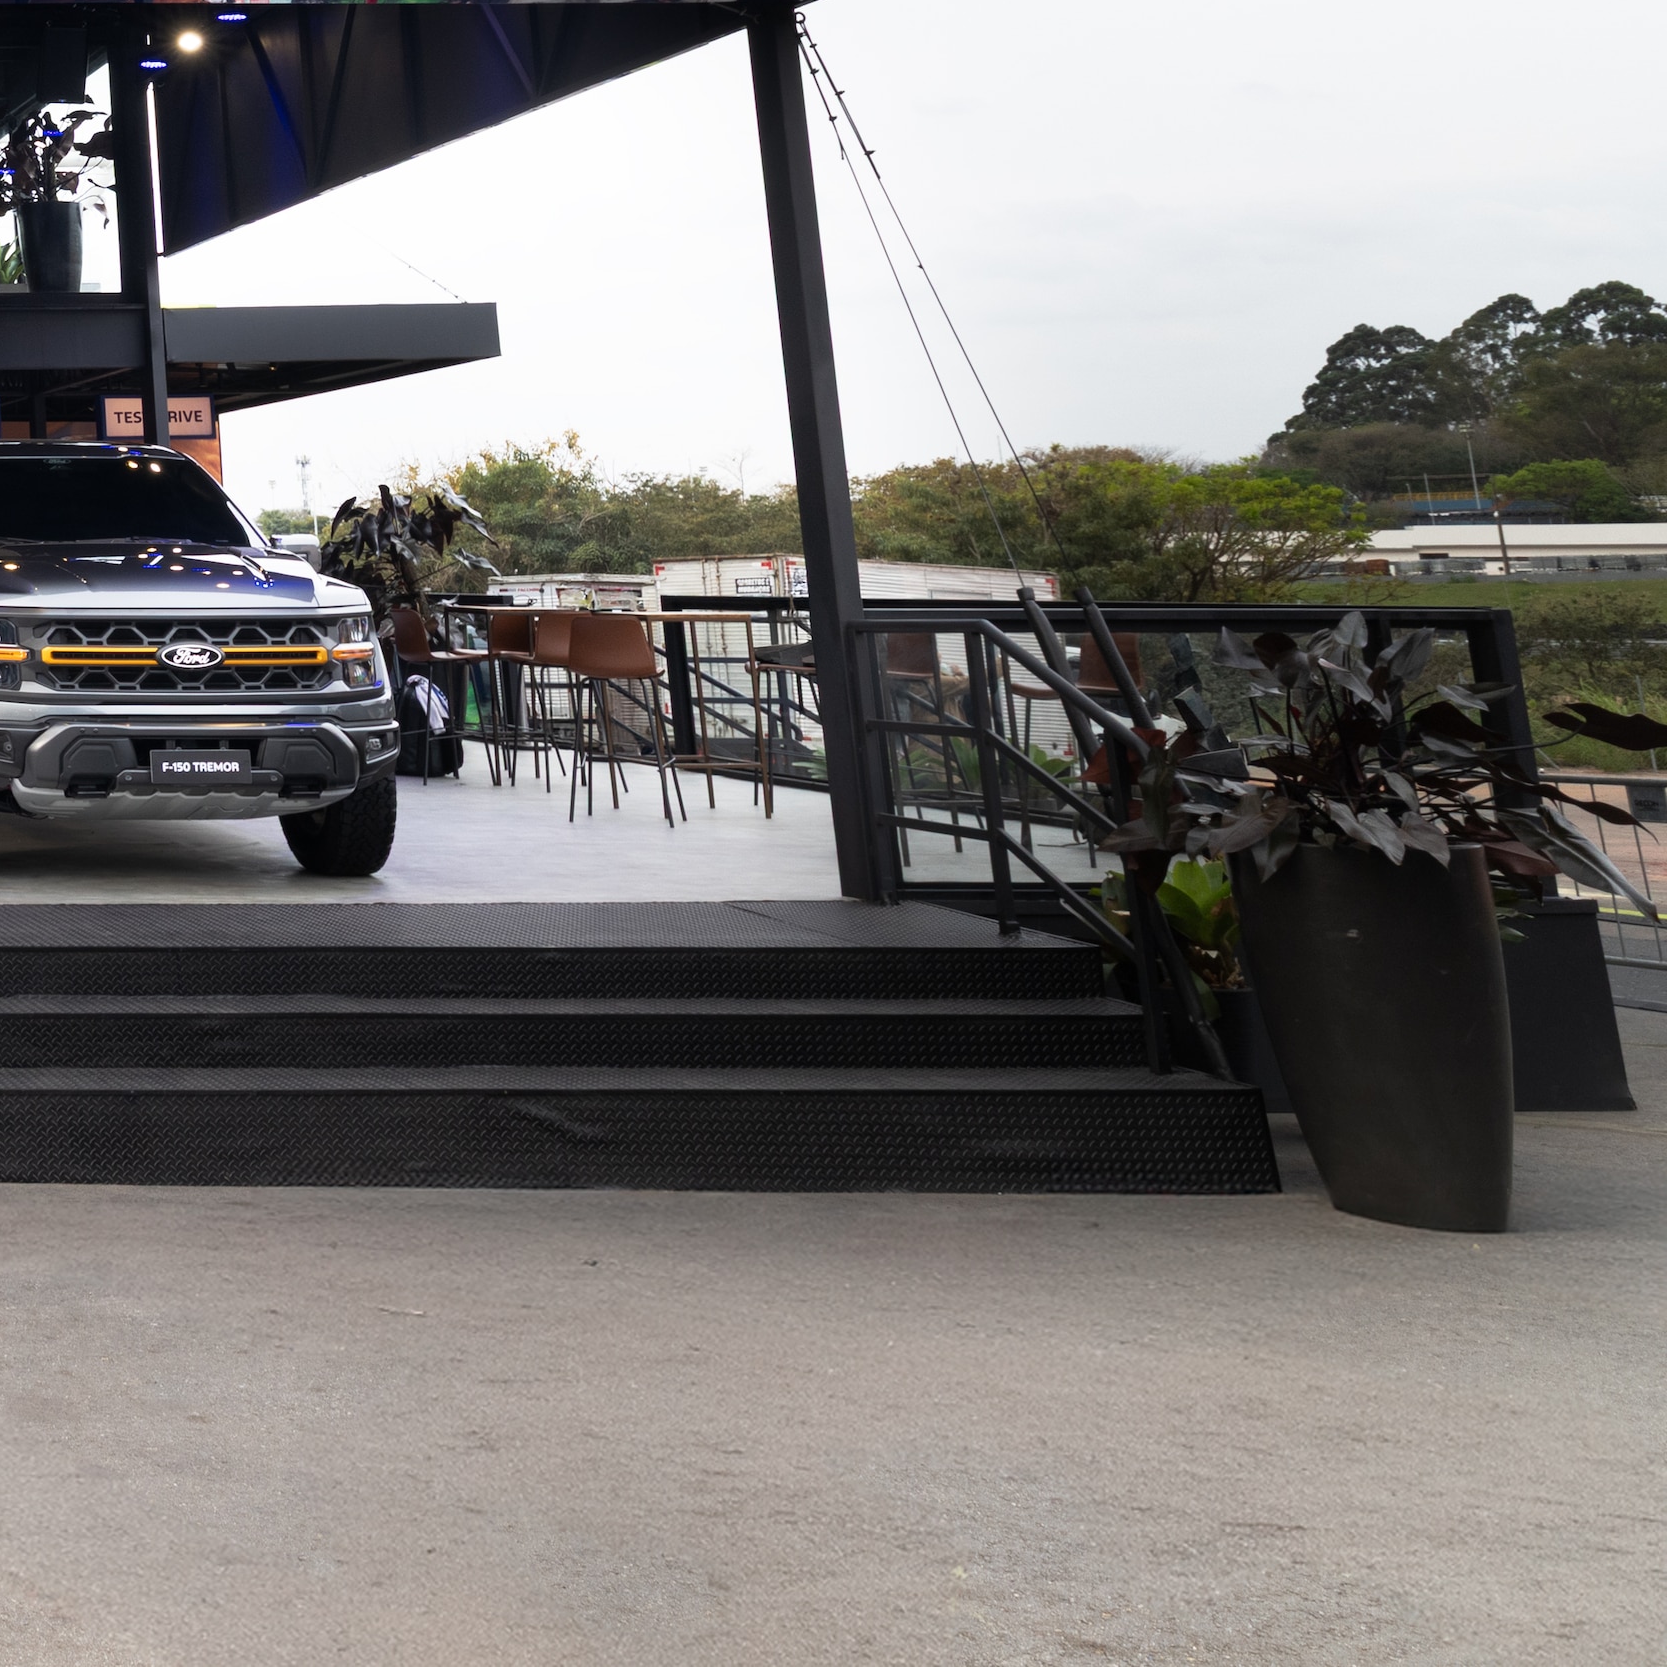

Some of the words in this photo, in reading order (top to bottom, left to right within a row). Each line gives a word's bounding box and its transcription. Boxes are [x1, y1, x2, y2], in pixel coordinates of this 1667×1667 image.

[114, 411, 144, 424] TES
[168, 410, 203, 423] RIVE
[172, 646, 211, 665] Ford
[162, 761, 191, 773] F-150
[192, 761, 240, 773] TREMOR
